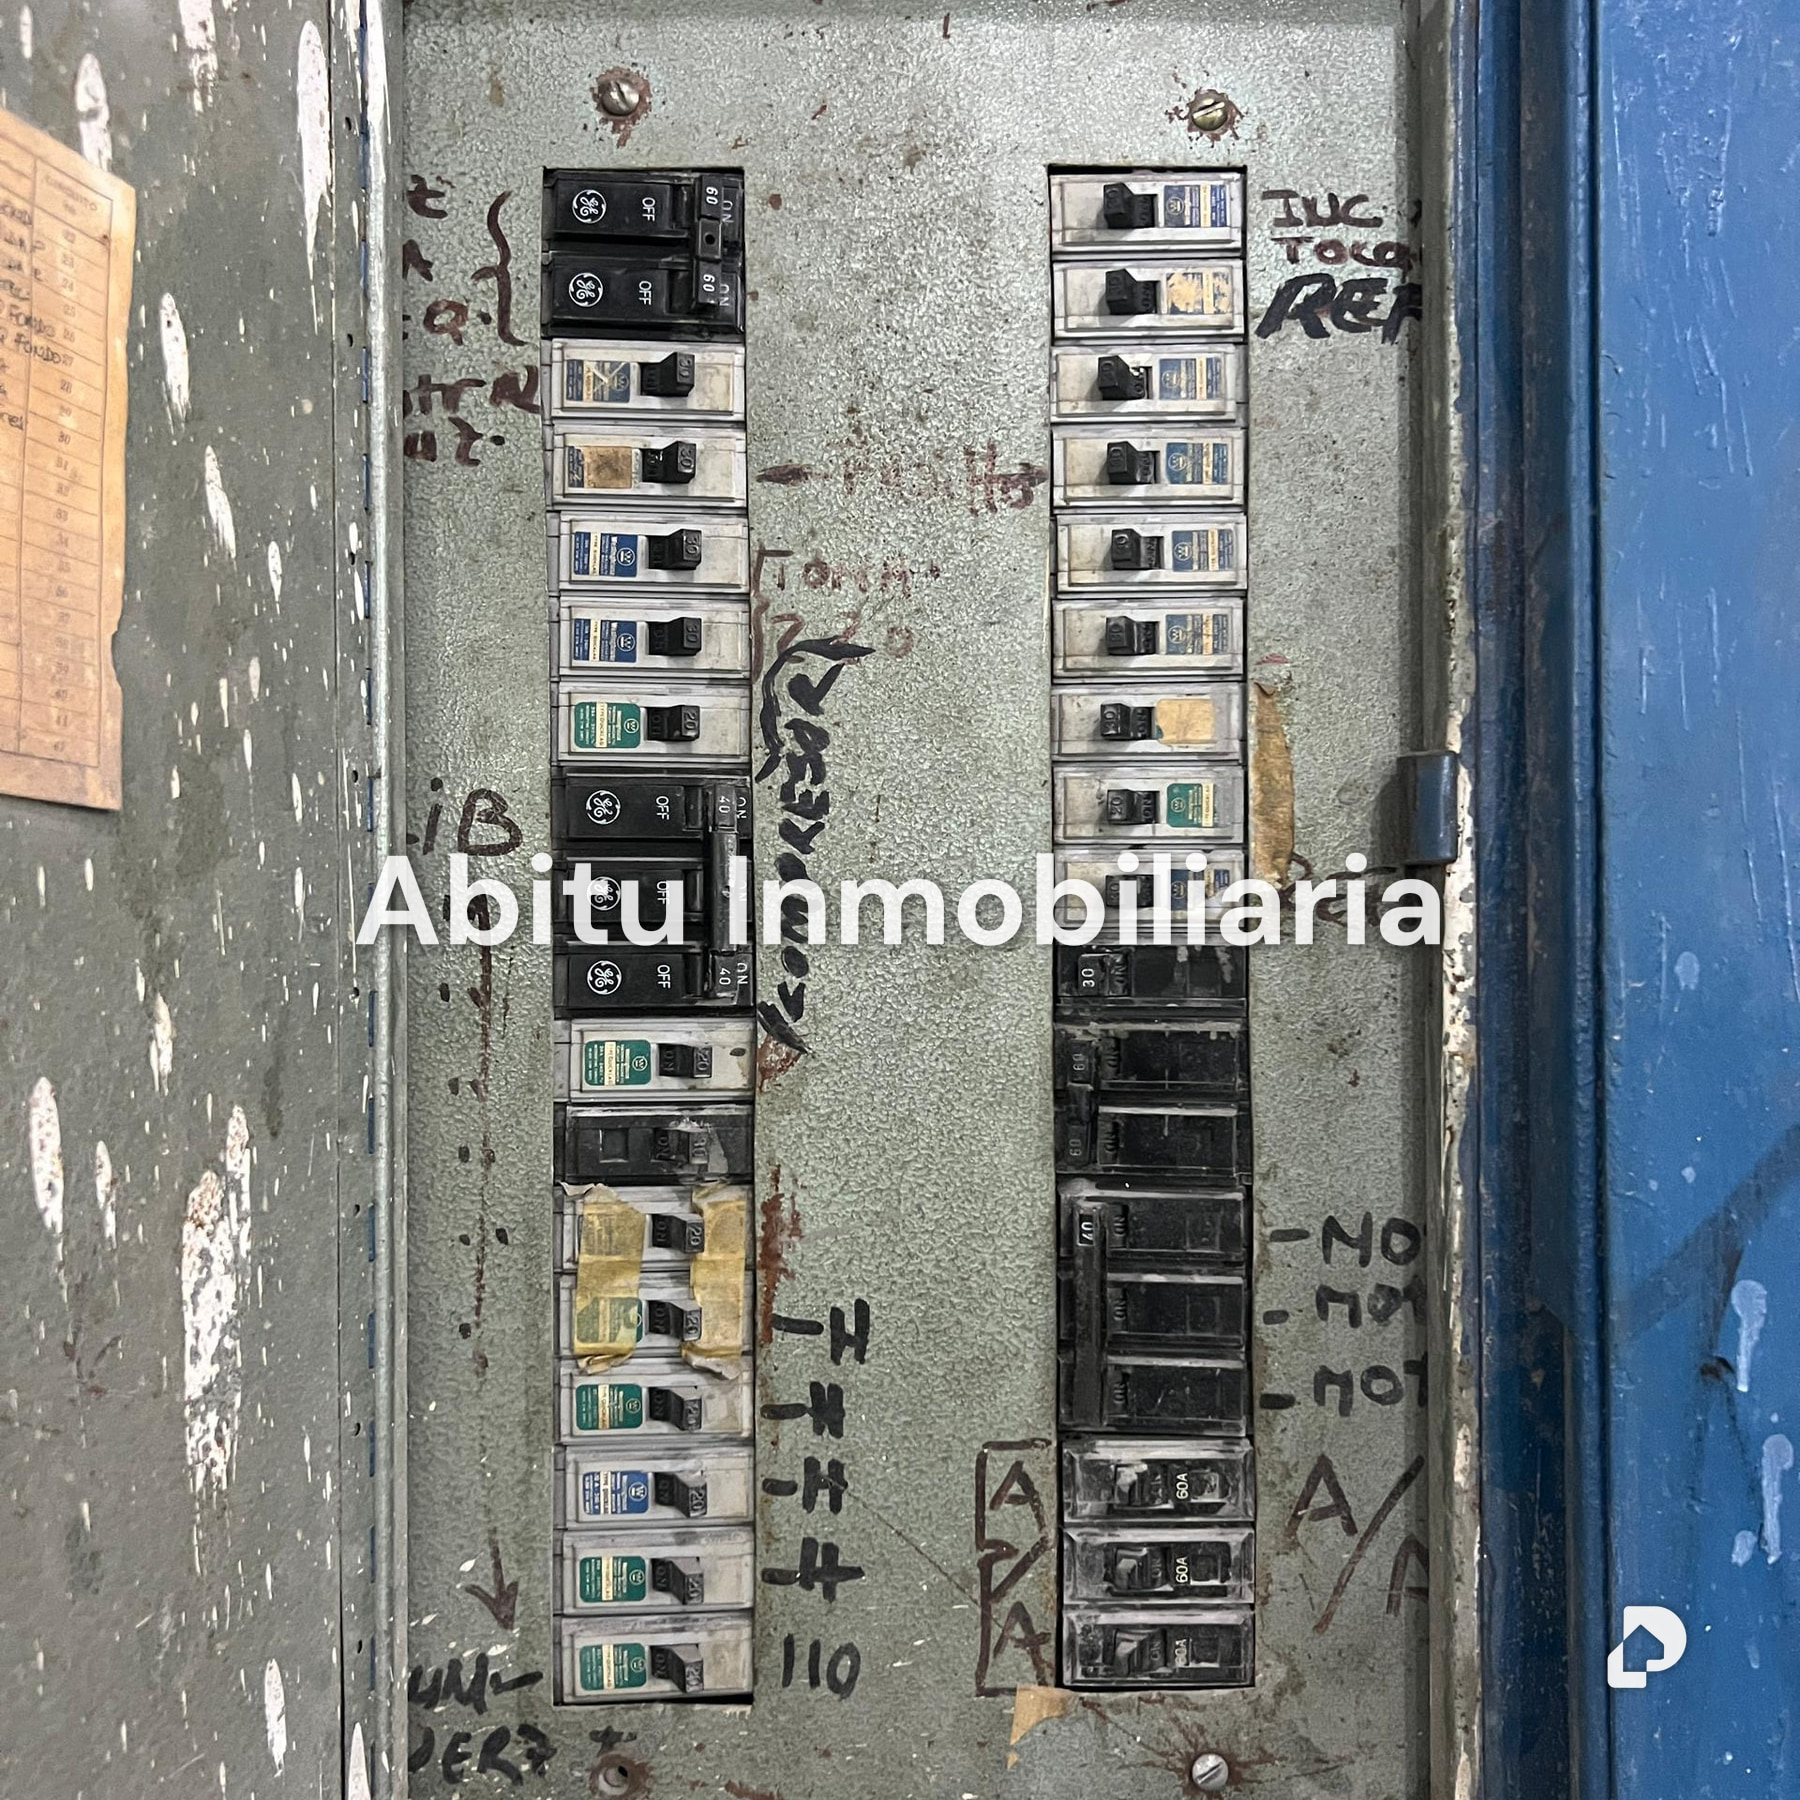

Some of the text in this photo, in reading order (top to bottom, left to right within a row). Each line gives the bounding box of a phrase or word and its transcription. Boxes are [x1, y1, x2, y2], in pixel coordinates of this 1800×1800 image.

[705, 186, 719, 205] 60
[641, 197, 656, 222] OFF
[638, 280, 653, 306] OFF
[702, 273, 716, 293] 60
[683, 710, 698, 731] 20
[655, 795, 670, 821] OFF
[718, 795, 731, 814] 40
[656, 964, 671, 989] OFF
[719, 967, 731, 985] 40
[1081, 968, 1096, 988] 30
[696, 1047, 710, 1071] 20
[1072, 1052, 1086, 1071] 60
[1069, 1138, 1082, 1156] 60
[689, 1226, 702, 1245] 20
[686, 1314, 699, 1334] 20
[1176, 1472, 1189, 1499] 60A
[1175, 1556, 1189, 1583] 60A
[781, 1633, 862, 1700] 110
